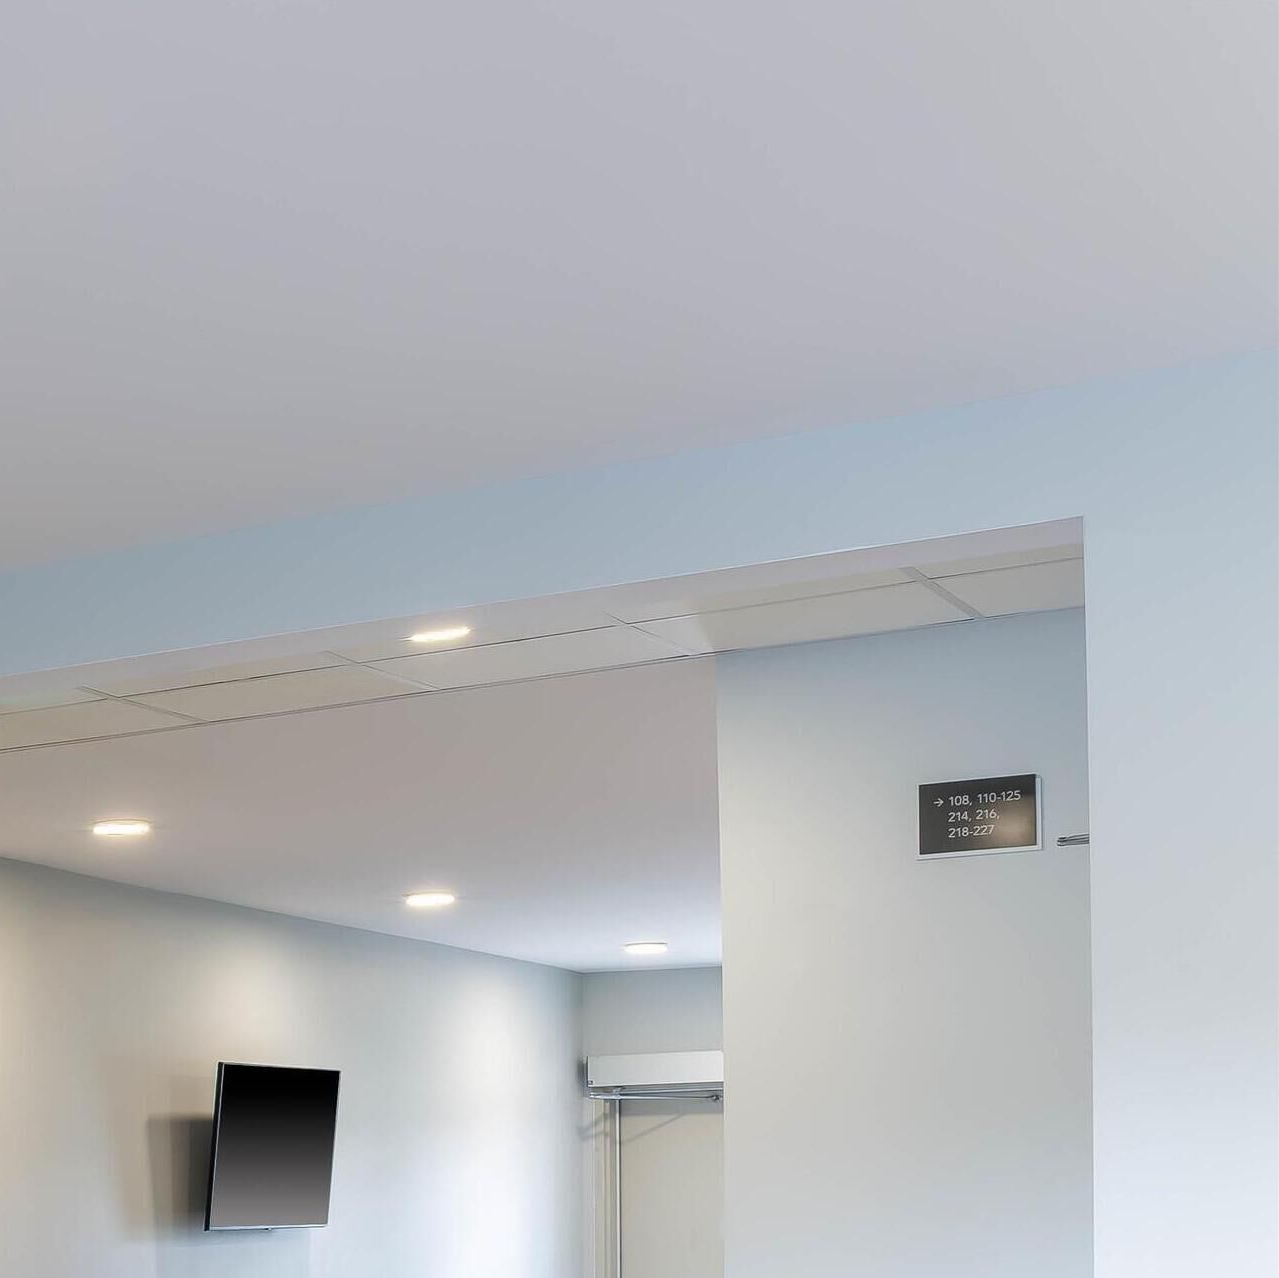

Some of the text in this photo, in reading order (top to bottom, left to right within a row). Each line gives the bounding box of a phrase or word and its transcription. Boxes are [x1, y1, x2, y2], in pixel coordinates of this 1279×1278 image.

[948, 790, 1021, 806] 108, 110-125
[948, 809, 1000, 823] 214, 216,
[948, 824, 995, 838] 218-227
